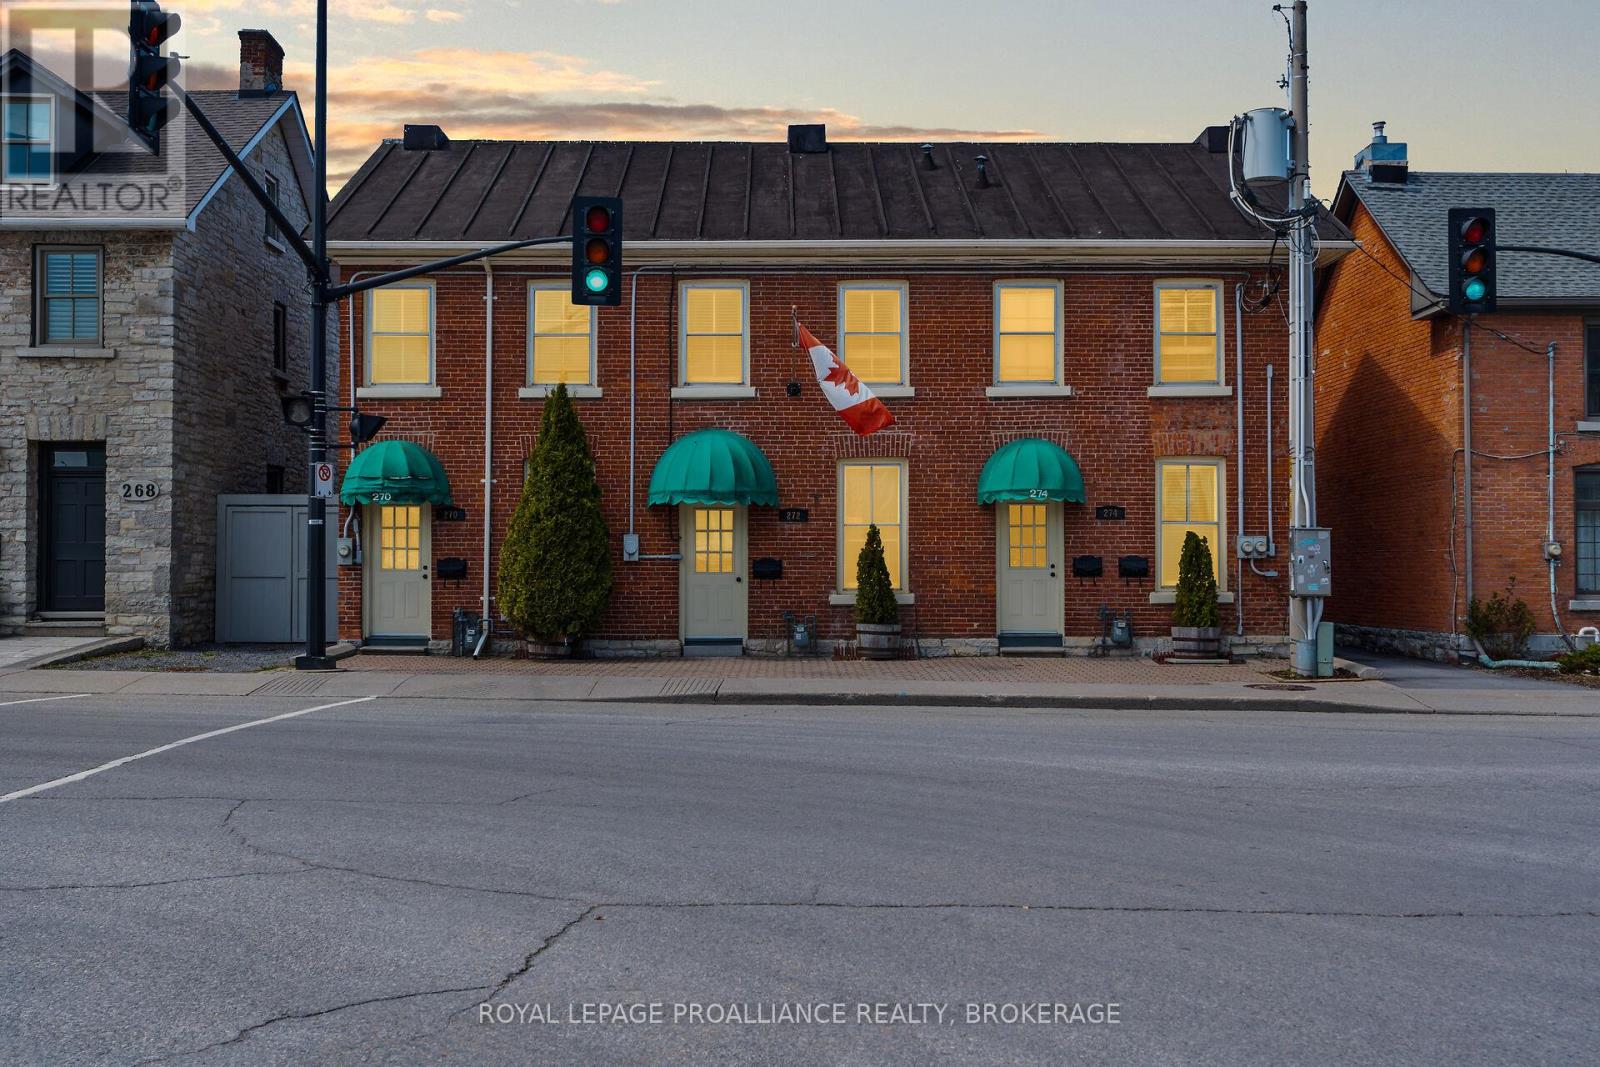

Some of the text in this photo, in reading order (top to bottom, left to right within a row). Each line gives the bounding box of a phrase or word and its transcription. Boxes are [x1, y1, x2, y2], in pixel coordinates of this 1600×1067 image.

[122, 484, 156, 497] 268
[1029, 489, 1048, 498] 274
[372, 493, 391, 501] 270
[786, 511, 801, 520] 272
[1103, 508, 1118, 517] 274
